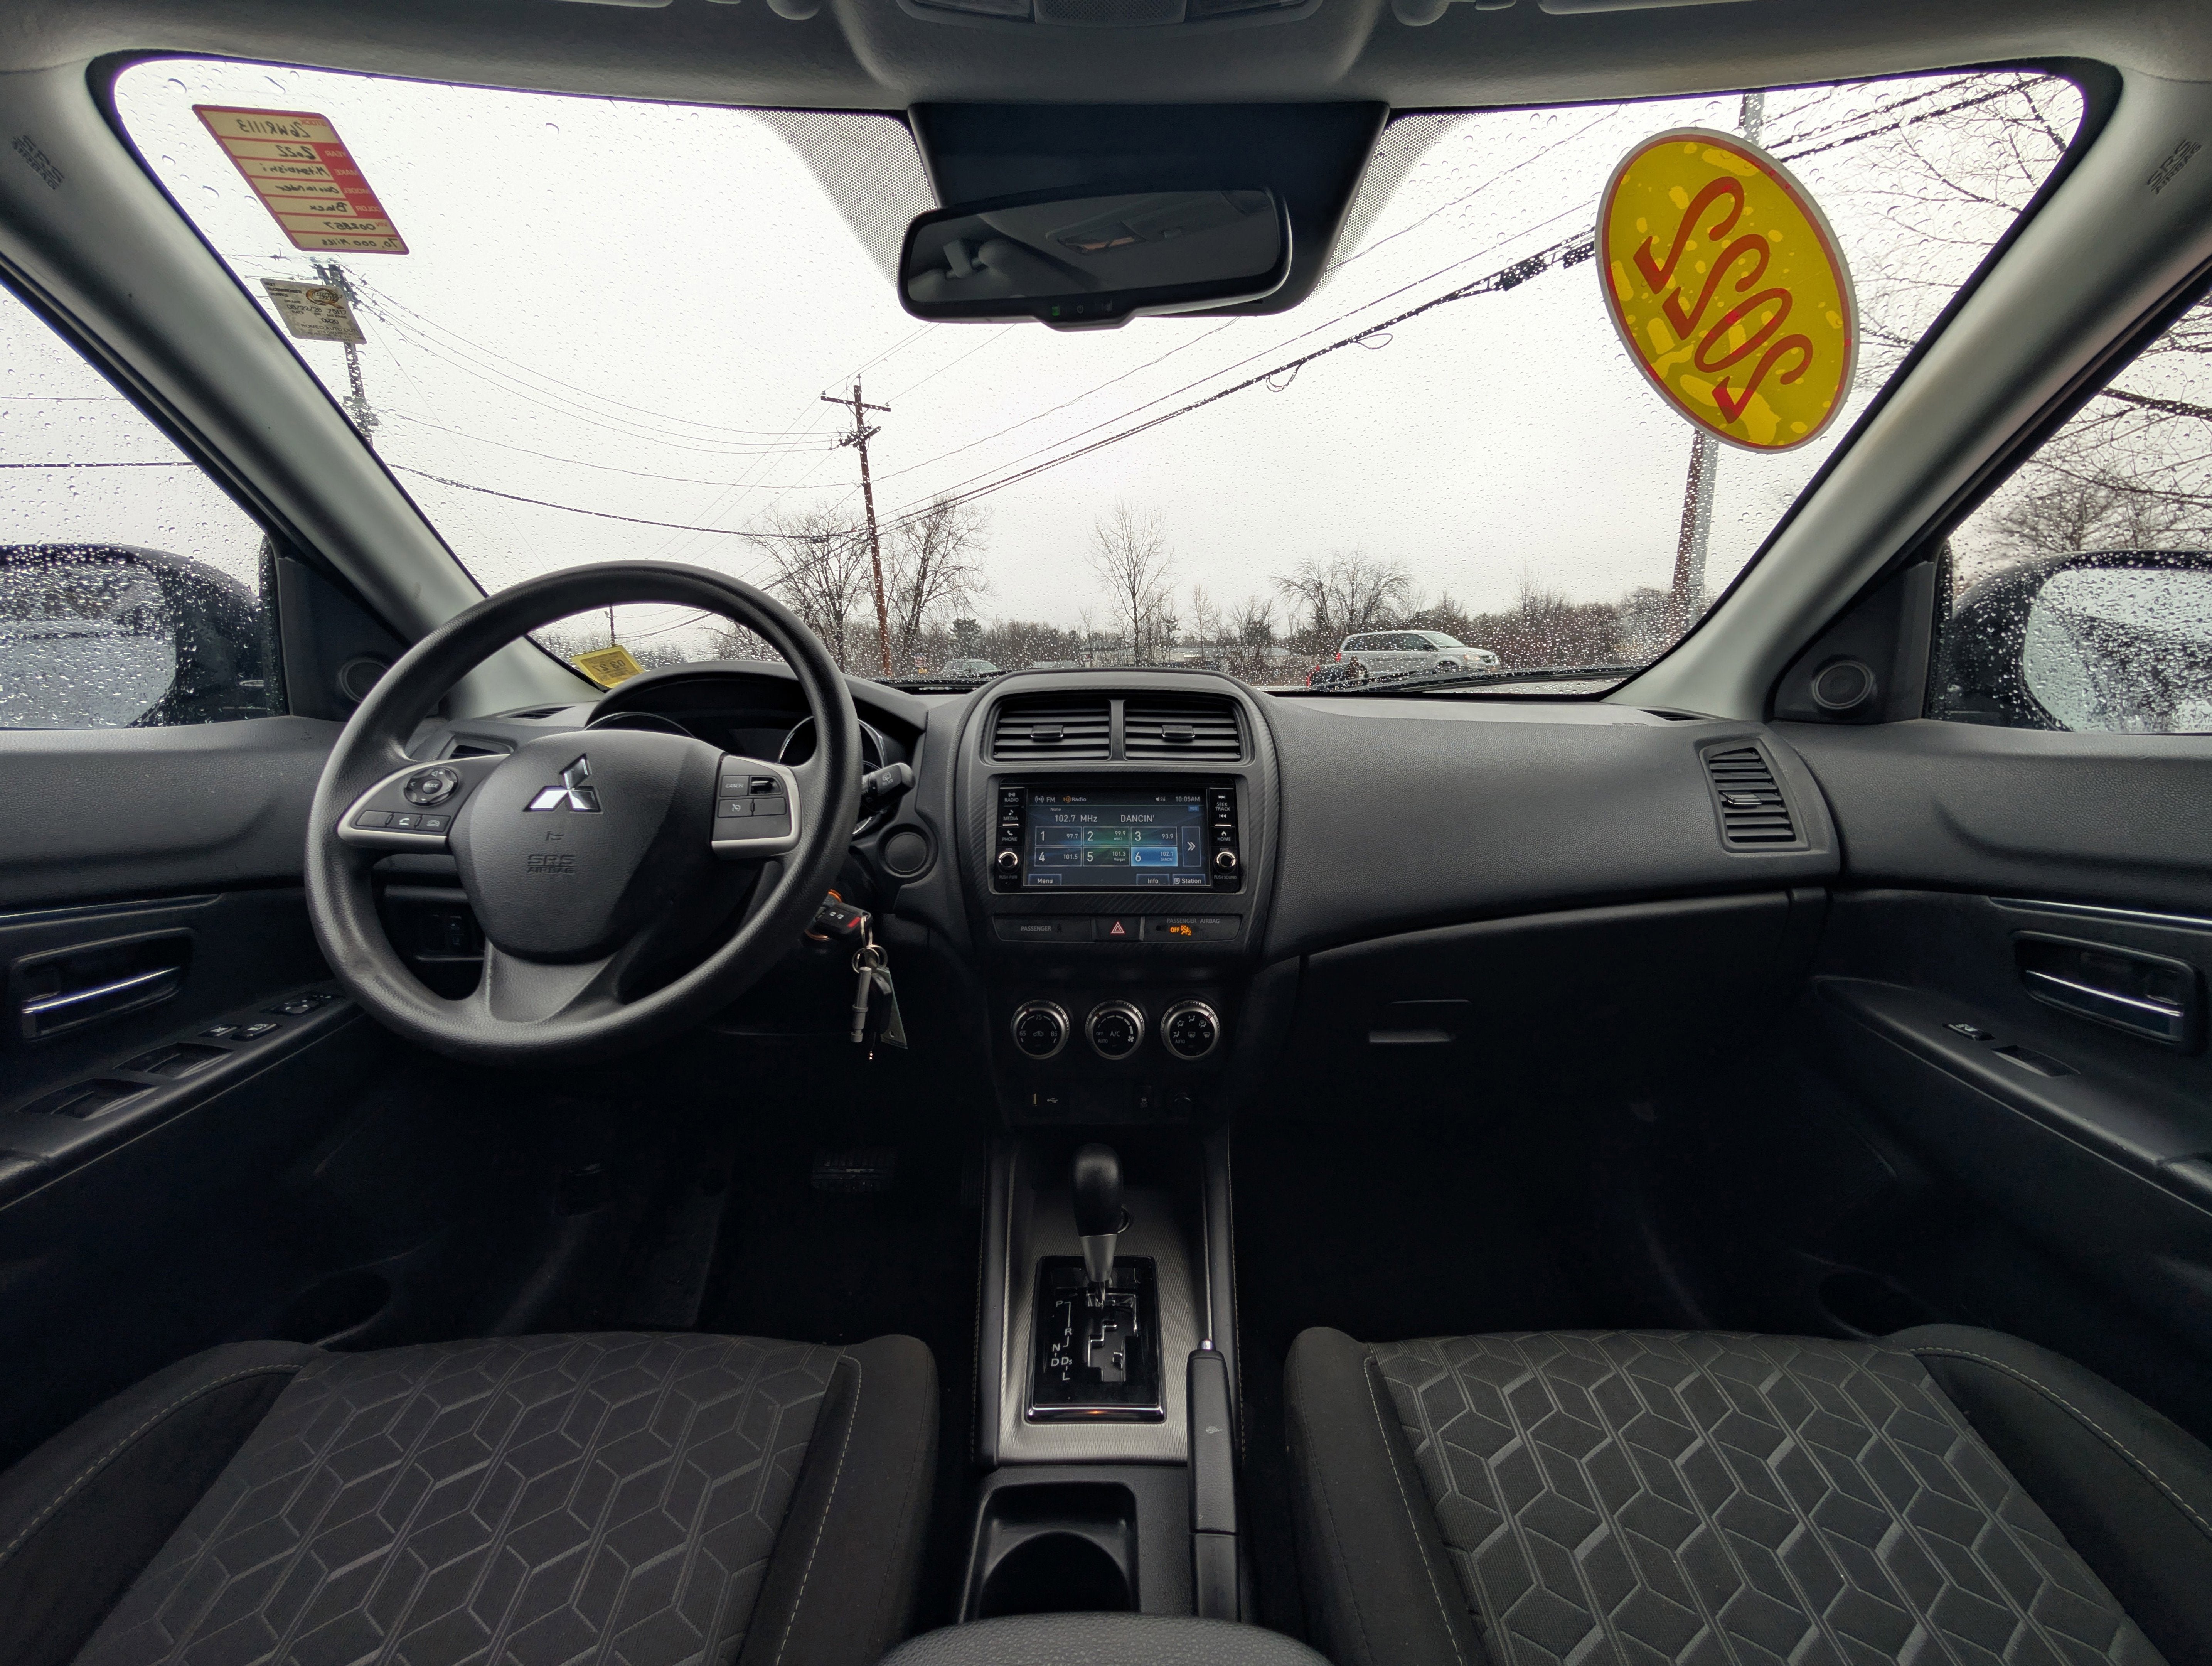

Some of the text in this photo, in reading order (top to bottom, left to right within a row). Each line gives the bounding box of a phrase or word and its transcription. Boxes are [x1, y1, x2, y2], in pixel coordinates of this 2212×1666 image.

[17, 135, 65, 183] SRS
[2147, 139, 2192, 187] SRS
[1120, 814, 1155, 823] DANCIN'
[1041, 831, 1045, 841] 1
[1087, 831, 1093, 841] 2
[1135, 831, 1141, 841] 3
[527, 854, 575, 865] SRS
[1038, 852, 1045, 862] 4
[1087, 852, 1093, 862] 5
[1135, 852, 1142, 862] 6
[1052, 1343, 1060, 1352] N
[1051, 1358, 1060, 1367] D
[1062, 1372, 1070, 1381] L
